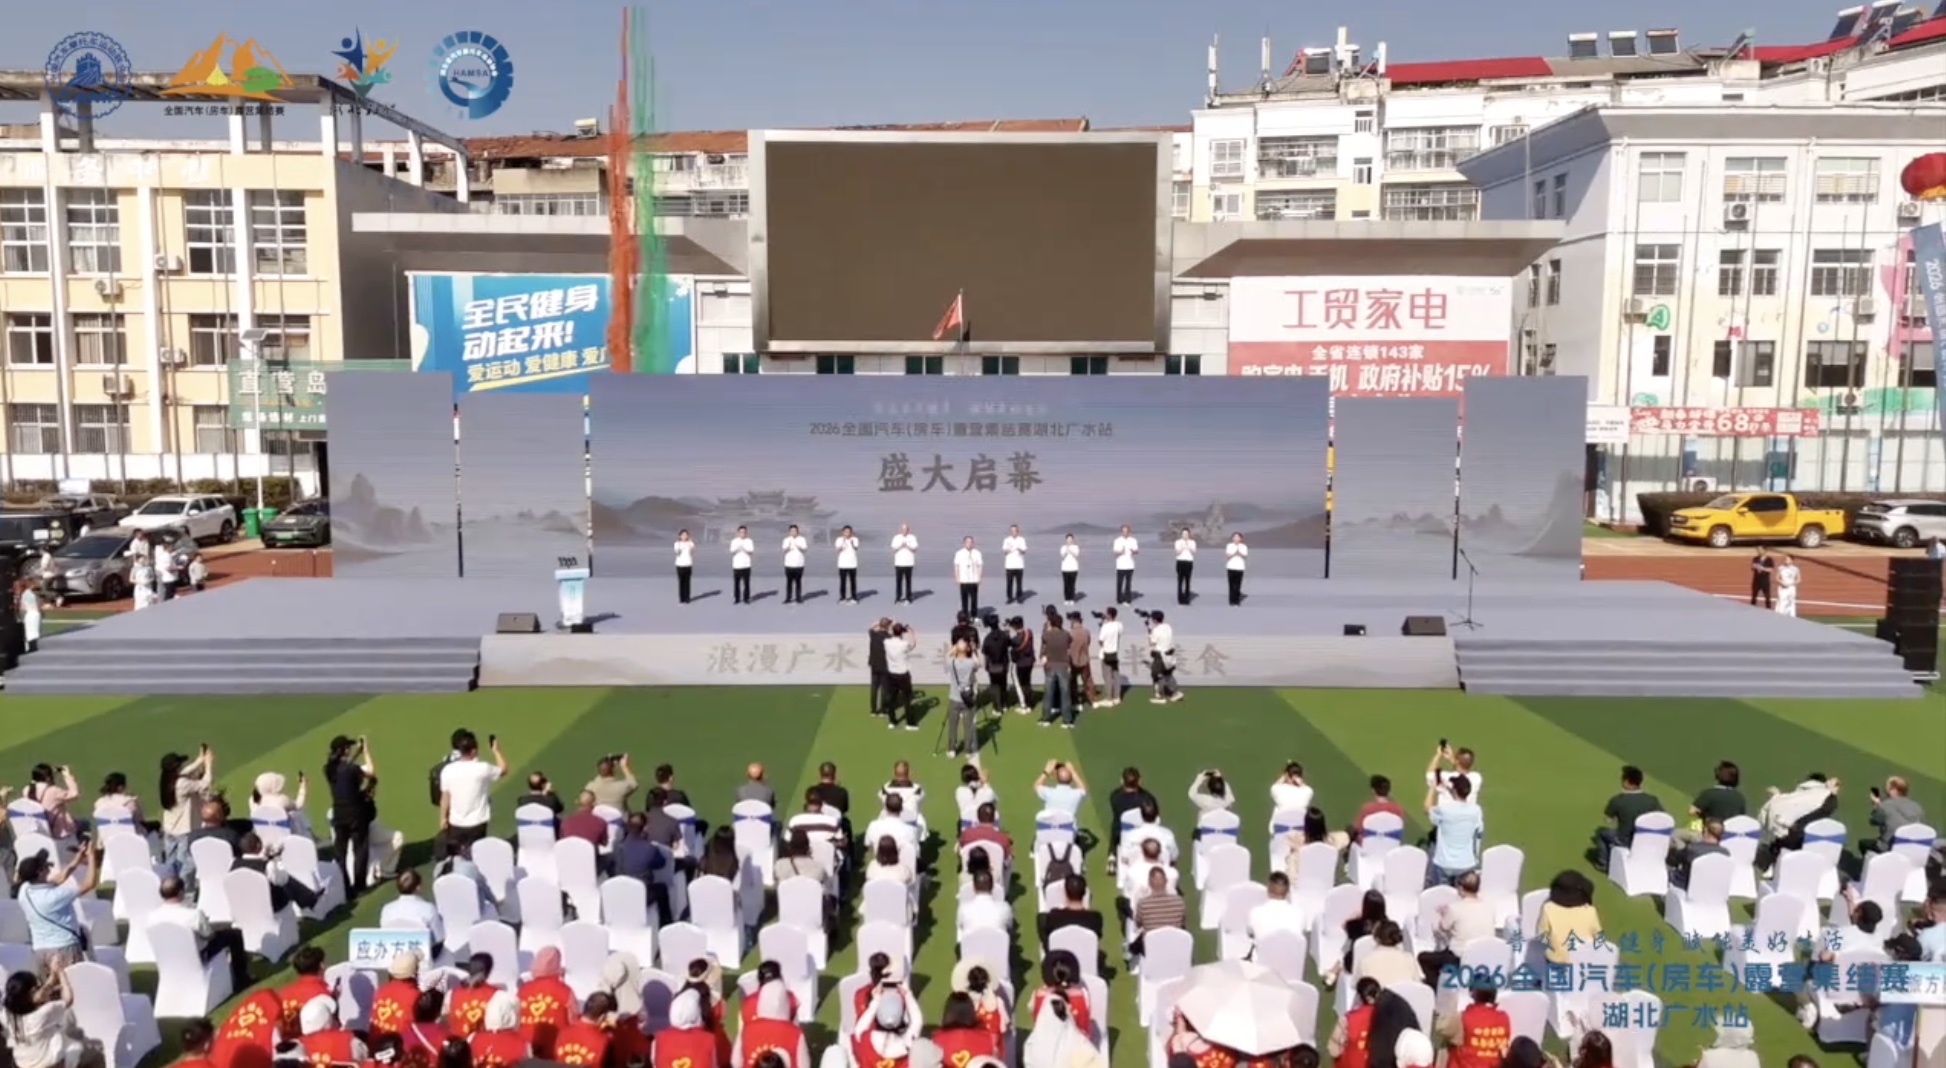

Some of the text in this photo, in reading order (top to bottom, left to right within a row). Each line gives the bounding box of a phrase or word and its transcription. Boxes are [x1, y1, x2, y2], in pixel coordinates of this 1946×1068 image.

[1925, 258, 1943, 291] 2026
[461, 284, 599, 330] 全民健身
[1282, 287, 1447, 330] 工贸家电
[462, 320, 575, 361] 动起来!
[1311, 343, 1425, 361] 全省连锁143家
[467, 357, 522, 383] 爱运动
[524, 350, 579, 375] 爱健康
[877, 451, 1044, 494] 盛大启幕
[707, 642, 859, 675] 浪漫广水
